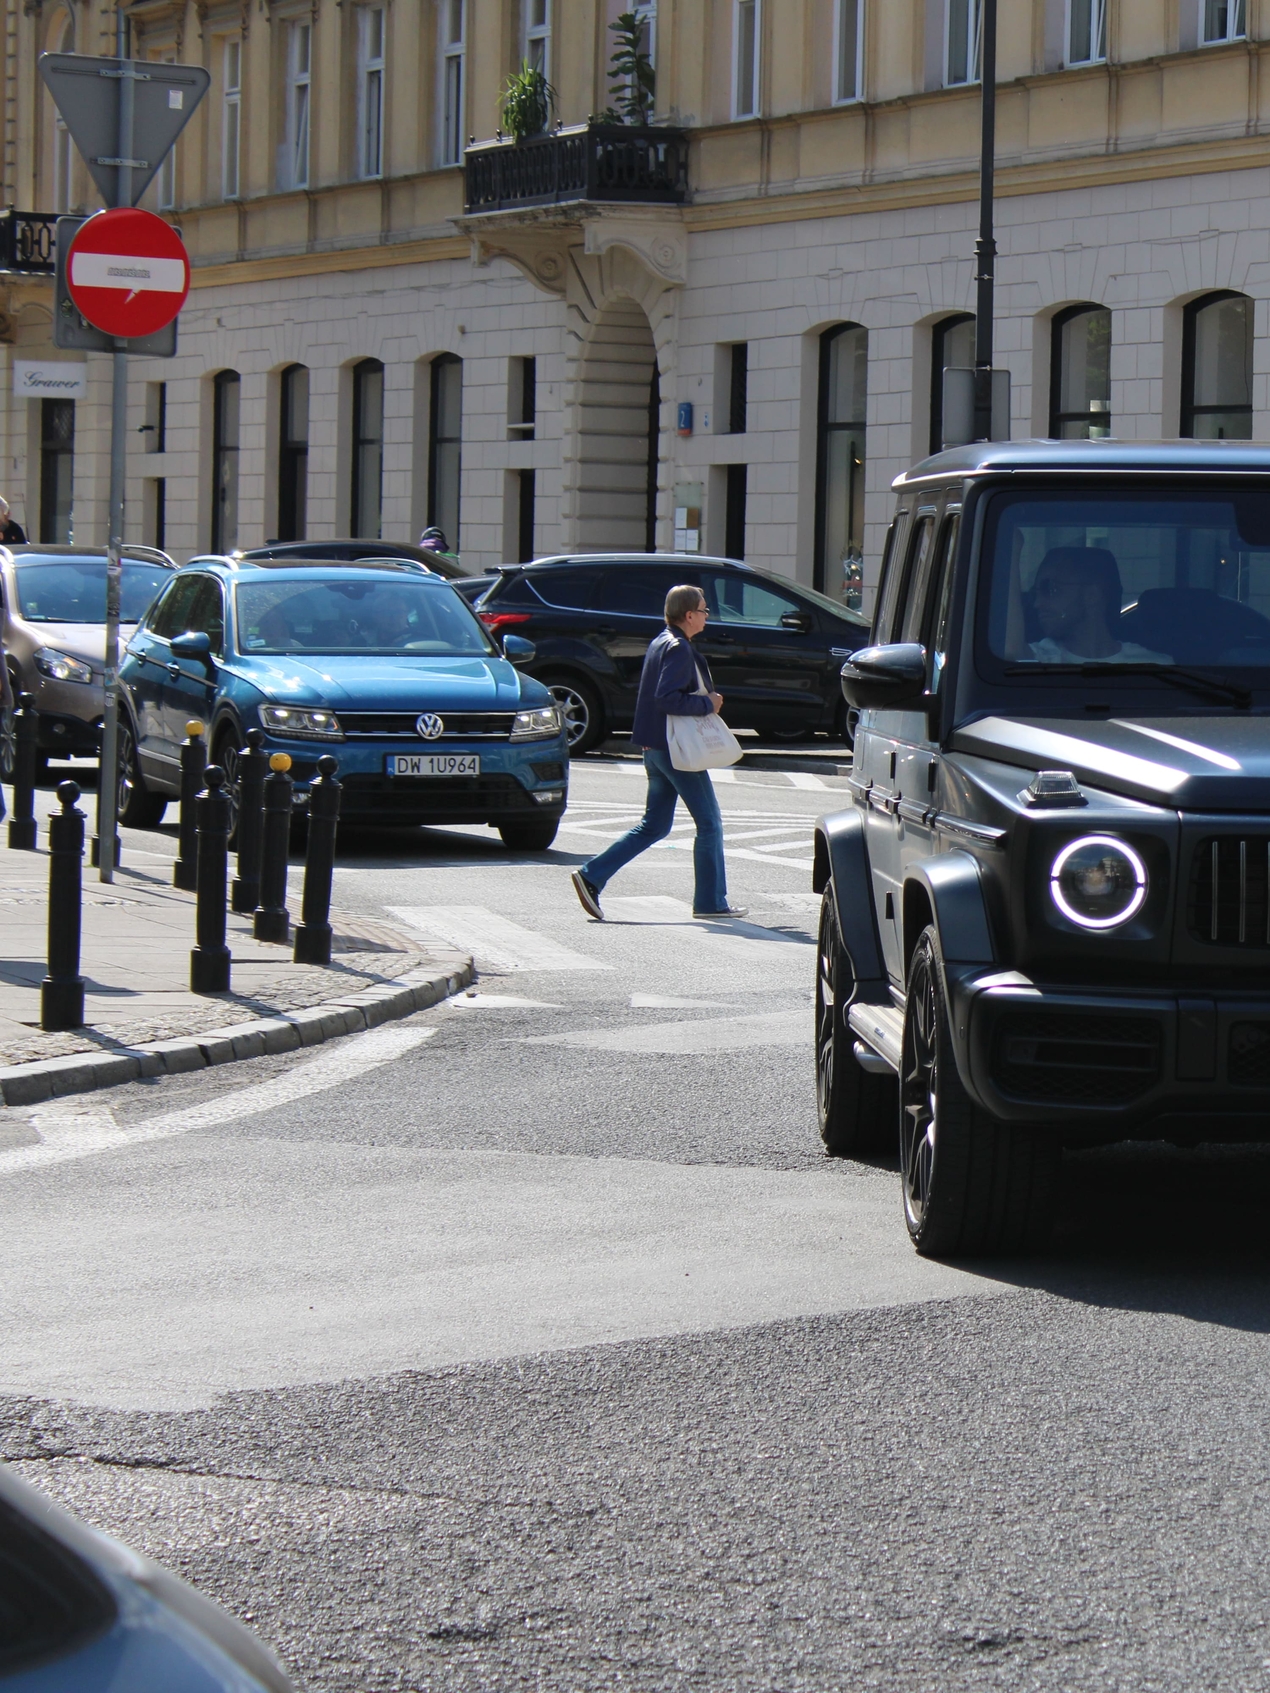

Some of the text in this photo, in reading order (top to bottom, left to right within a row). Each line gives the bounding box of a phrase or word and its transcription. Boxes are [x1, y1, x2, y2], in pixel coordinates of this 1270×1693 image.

[23, 371, 80, 388] Grawer
[680, 410, 685, 428] 2
[397, 757, 476, 774] DW 1U964
